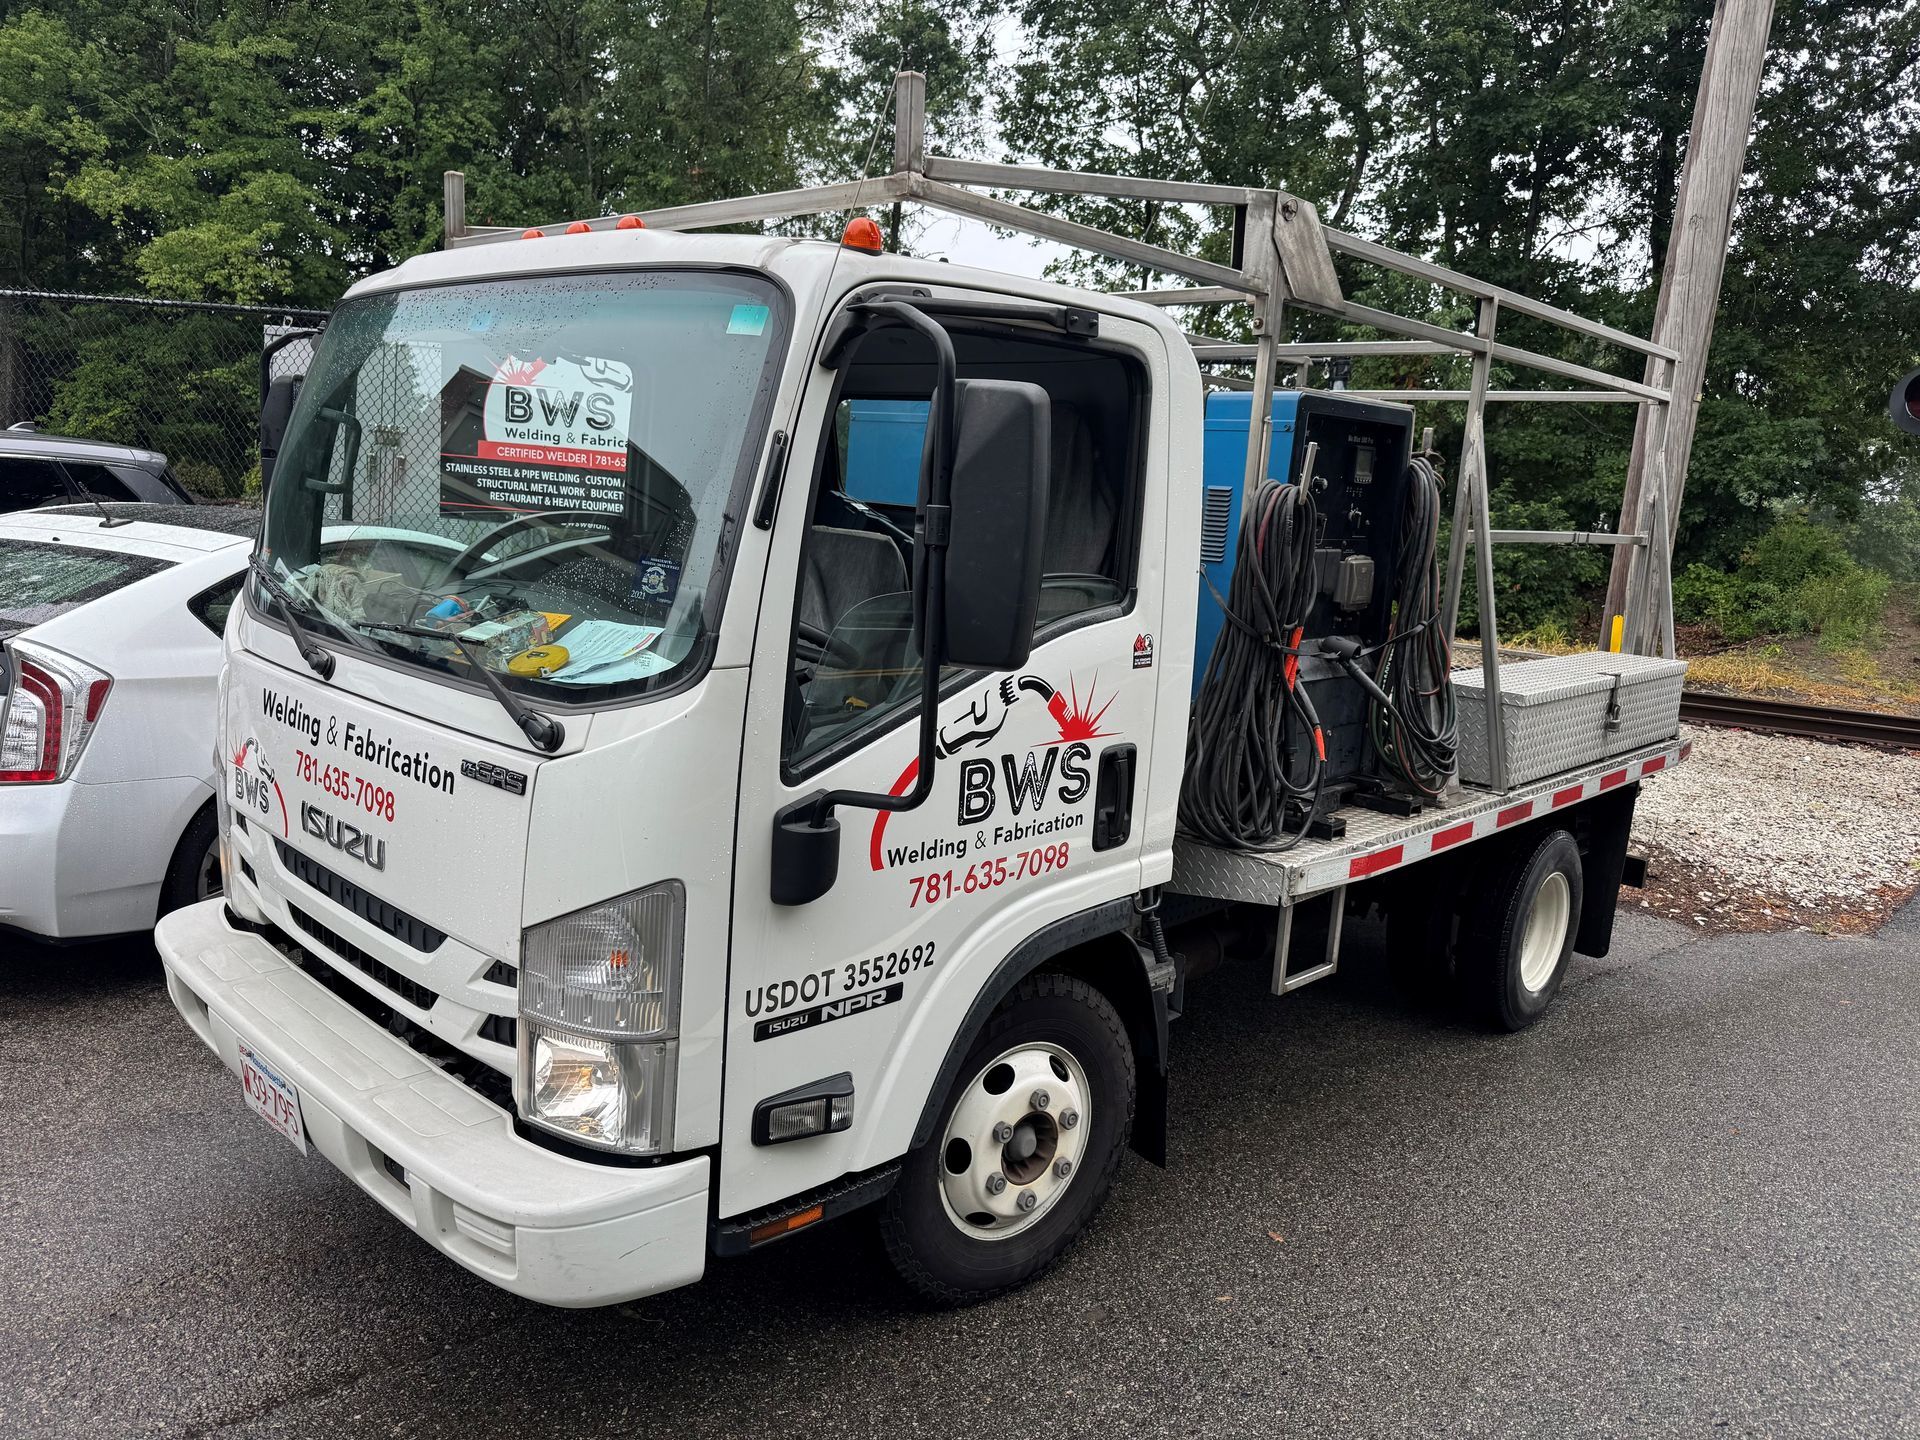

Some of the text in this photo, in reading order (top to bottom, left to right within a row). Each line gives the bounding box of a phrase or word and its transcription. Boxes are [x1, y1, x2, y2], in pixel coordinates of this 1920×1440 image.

[506, 386, 616, 431] BWS
[497, 446, 544, 460] CERTIFIED
[546, 450, 587, 464] WELDER
[505, 427, 561, 446] Welding
[566, 432, 576, 444] &
[445, 462, 488, 475] STAINLESS
[489, 466, 512, 477] STEEL
[513, 468, 521, 478] &
[521, 469, 540, 479] PIPE
[541, 471, 580, 483] WELDING
[585, 475, 621, 487] CUSTOM
[477, 478, 529, 491] STRUCTURAL
[530, 482, 558, 494] METAL
[560, 485, 586, 497] WORK
[490, 491, 543, 505] RESTAURANT
[544, 496, 551, 506] &
[552, 497, 580, 508] HEAVY
[631, 590, 646, 600] 2021
[263, 688, 455, 795] Welding & Fabrication
[235, 767, 270, 814] BWS
[295, 749, 396, 822] 781-635-7098
[476, 762, 524, 795] GAS
[958, 742, 1091, 826] BWS
[301, 800, 386, 872] ISUZU
[888, 812, 1083, 868] Welding & Fabrication
[909, 841, 1070, 909] 781-635-7098
[745, 941, 935, 1017] USDOT 3552692
[769, 989, 887, 1034] ISUZU NPR
